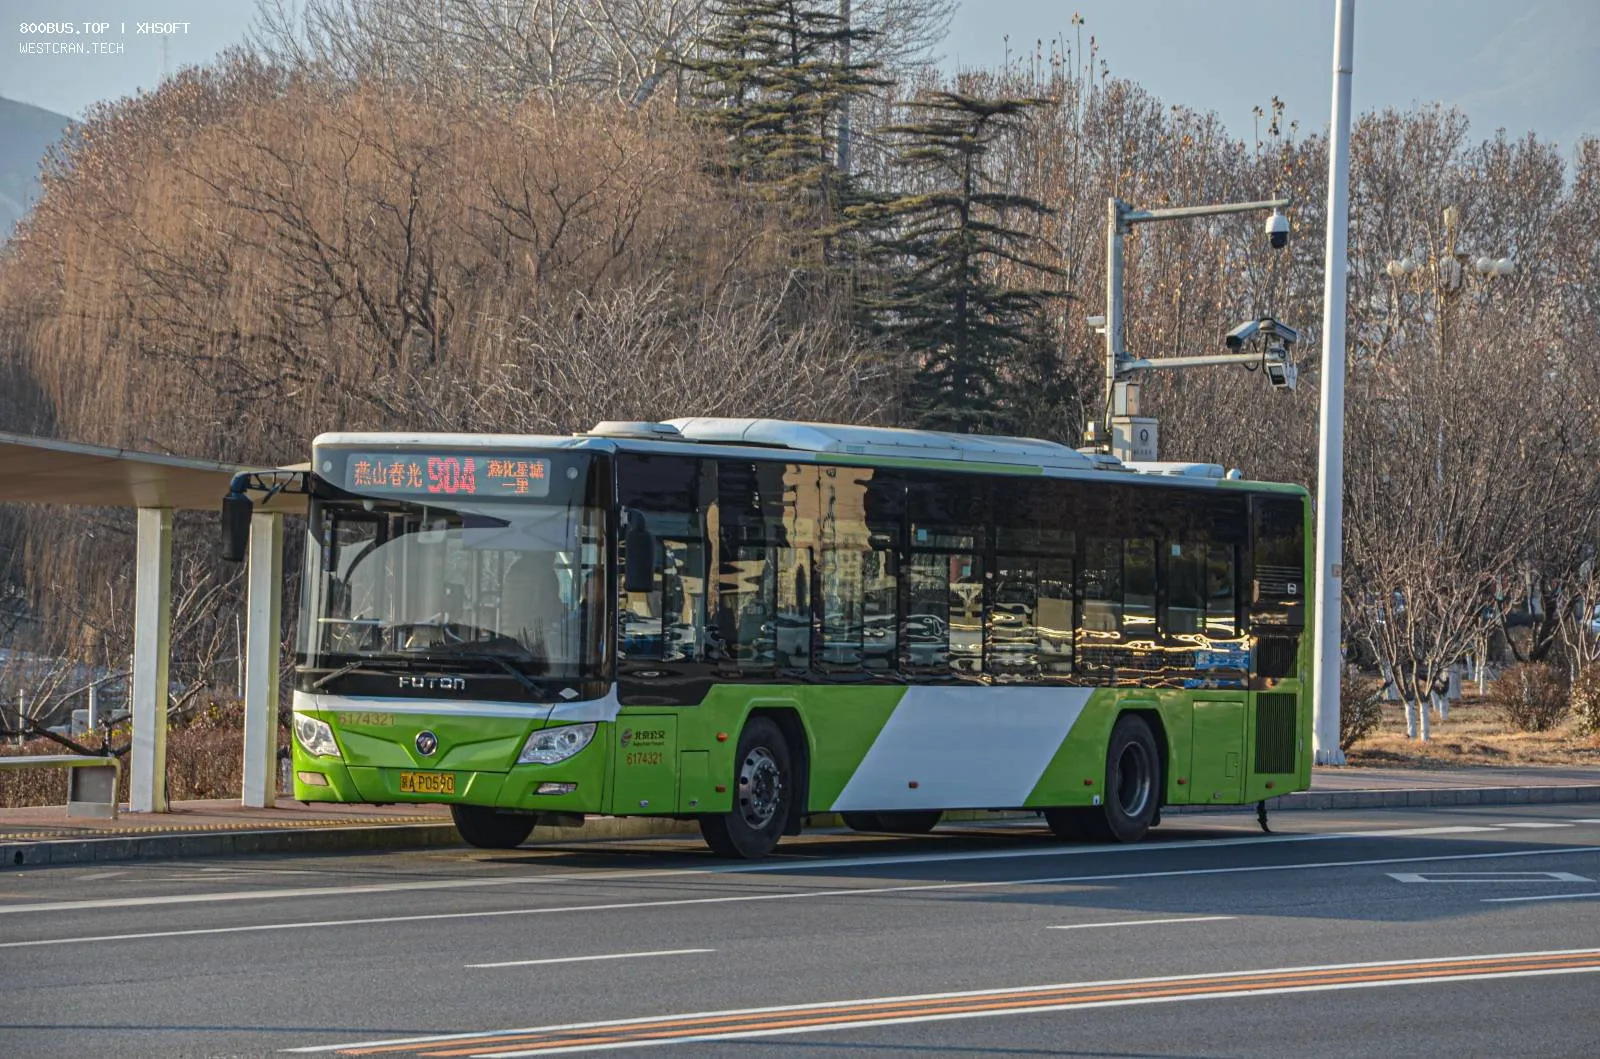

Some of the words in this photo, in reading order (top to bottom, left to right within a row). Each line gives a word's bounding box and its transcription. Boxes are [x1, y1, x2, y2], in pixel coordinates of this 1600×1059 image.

[354, 460, 423, 488] 燕山春光
[427, 455, 477, 494] 904
[338, 711, 396, 727] 6174321
[635, 730, 665, 740] 北京公交
[626, 752, 662, 766] 6174321
